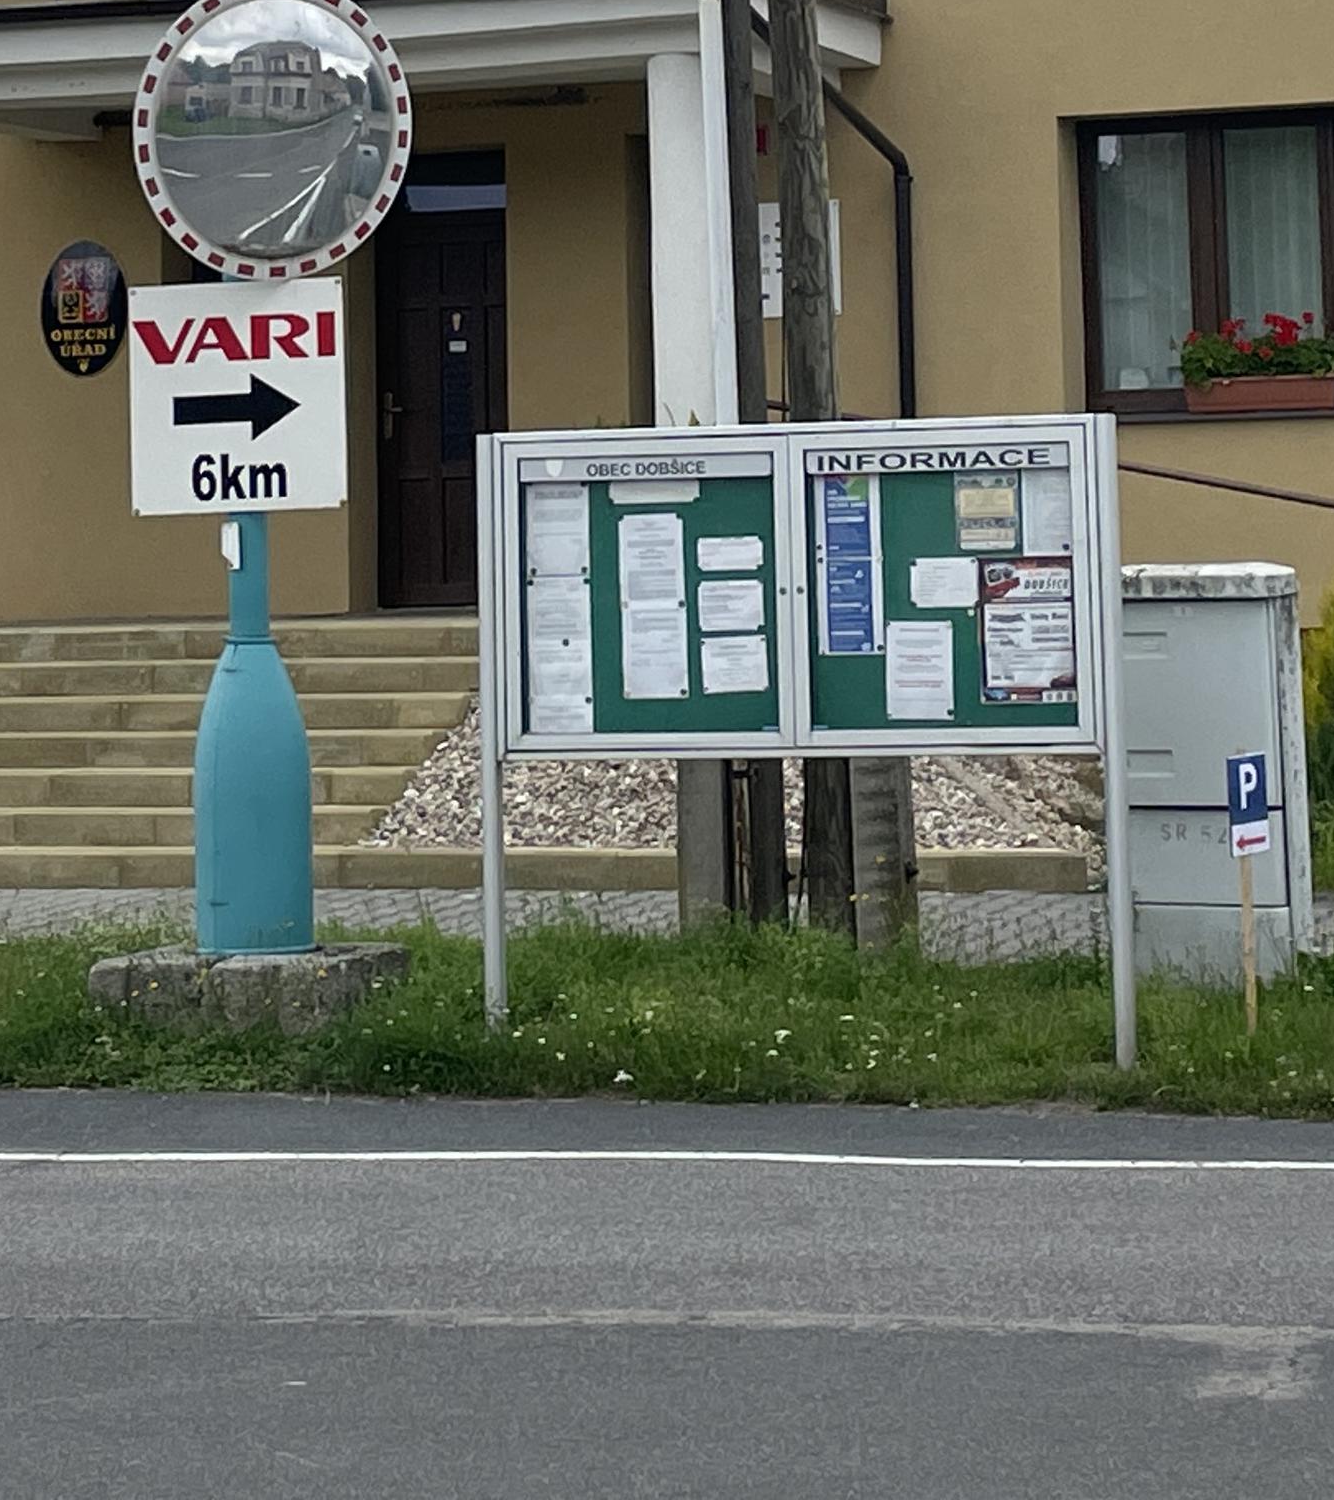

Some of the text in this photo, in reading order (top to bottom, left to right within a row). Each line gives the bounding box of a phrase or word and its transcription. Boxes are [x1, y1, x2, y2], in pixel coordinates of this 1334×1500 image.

[132, 311, 336, 365] VARI
[192, 453, 288, 501] 6km
[586, 458, 707, 478] OBEC DOBŠICE
[816, 447, 1051, 472] INFORMACE
[1238, 762, 1258, 811] P
[1160, 823, 1188, 841] SR
